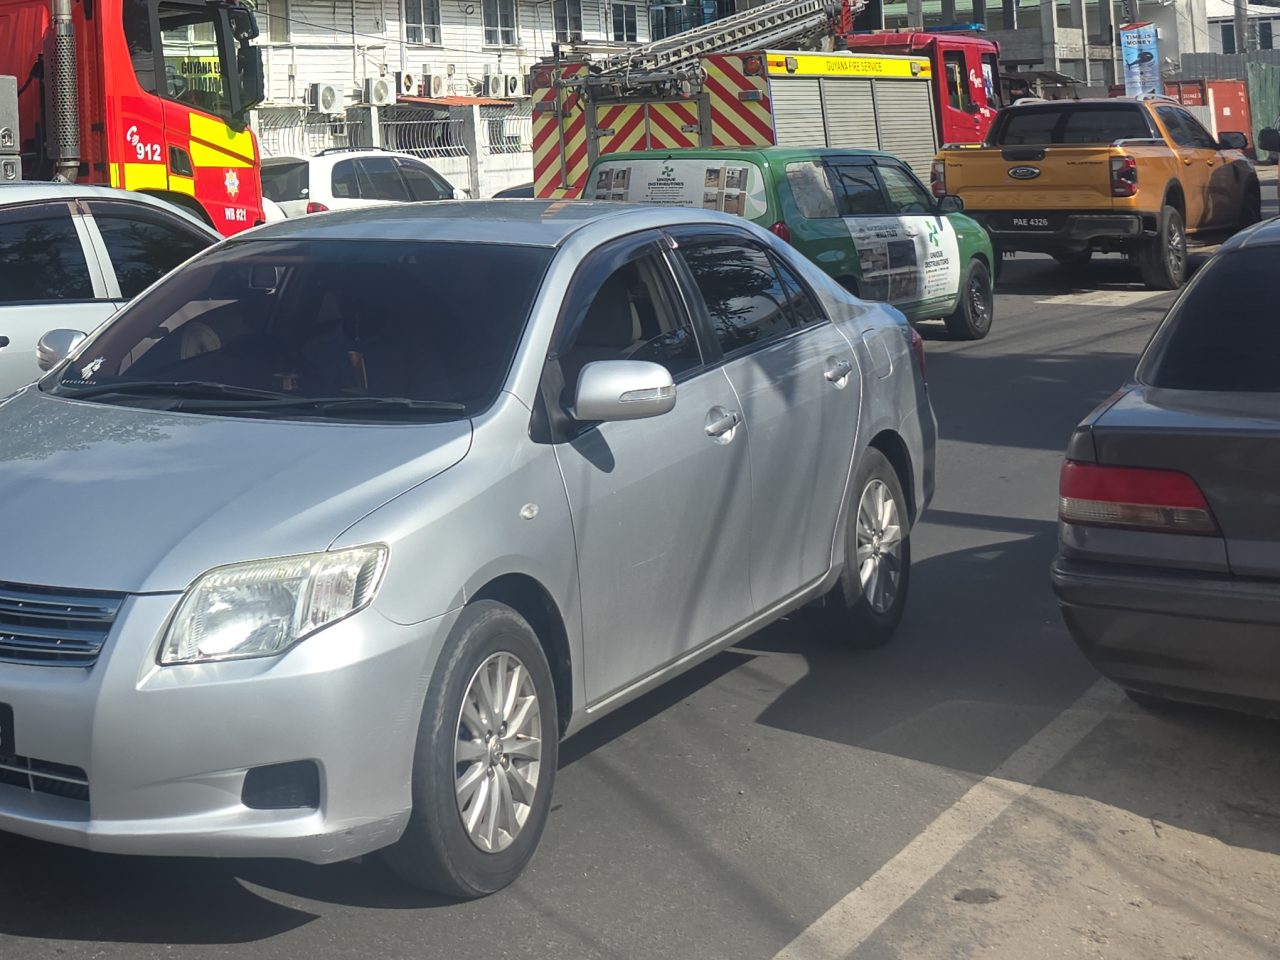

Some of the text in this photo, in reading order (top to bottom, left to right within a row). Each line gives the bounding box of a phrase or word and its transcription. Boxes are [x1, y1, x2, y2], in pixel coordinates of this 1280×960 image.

[181, 61, 212, 74] GUYANA
[826, 60, 883, 73] GUYANA FIRE SERVICE
[136, 143, 161, 161] 912
[224, 208, 247, 222] WB #21
[1013, 218, 1048, 226] PAE 4326
